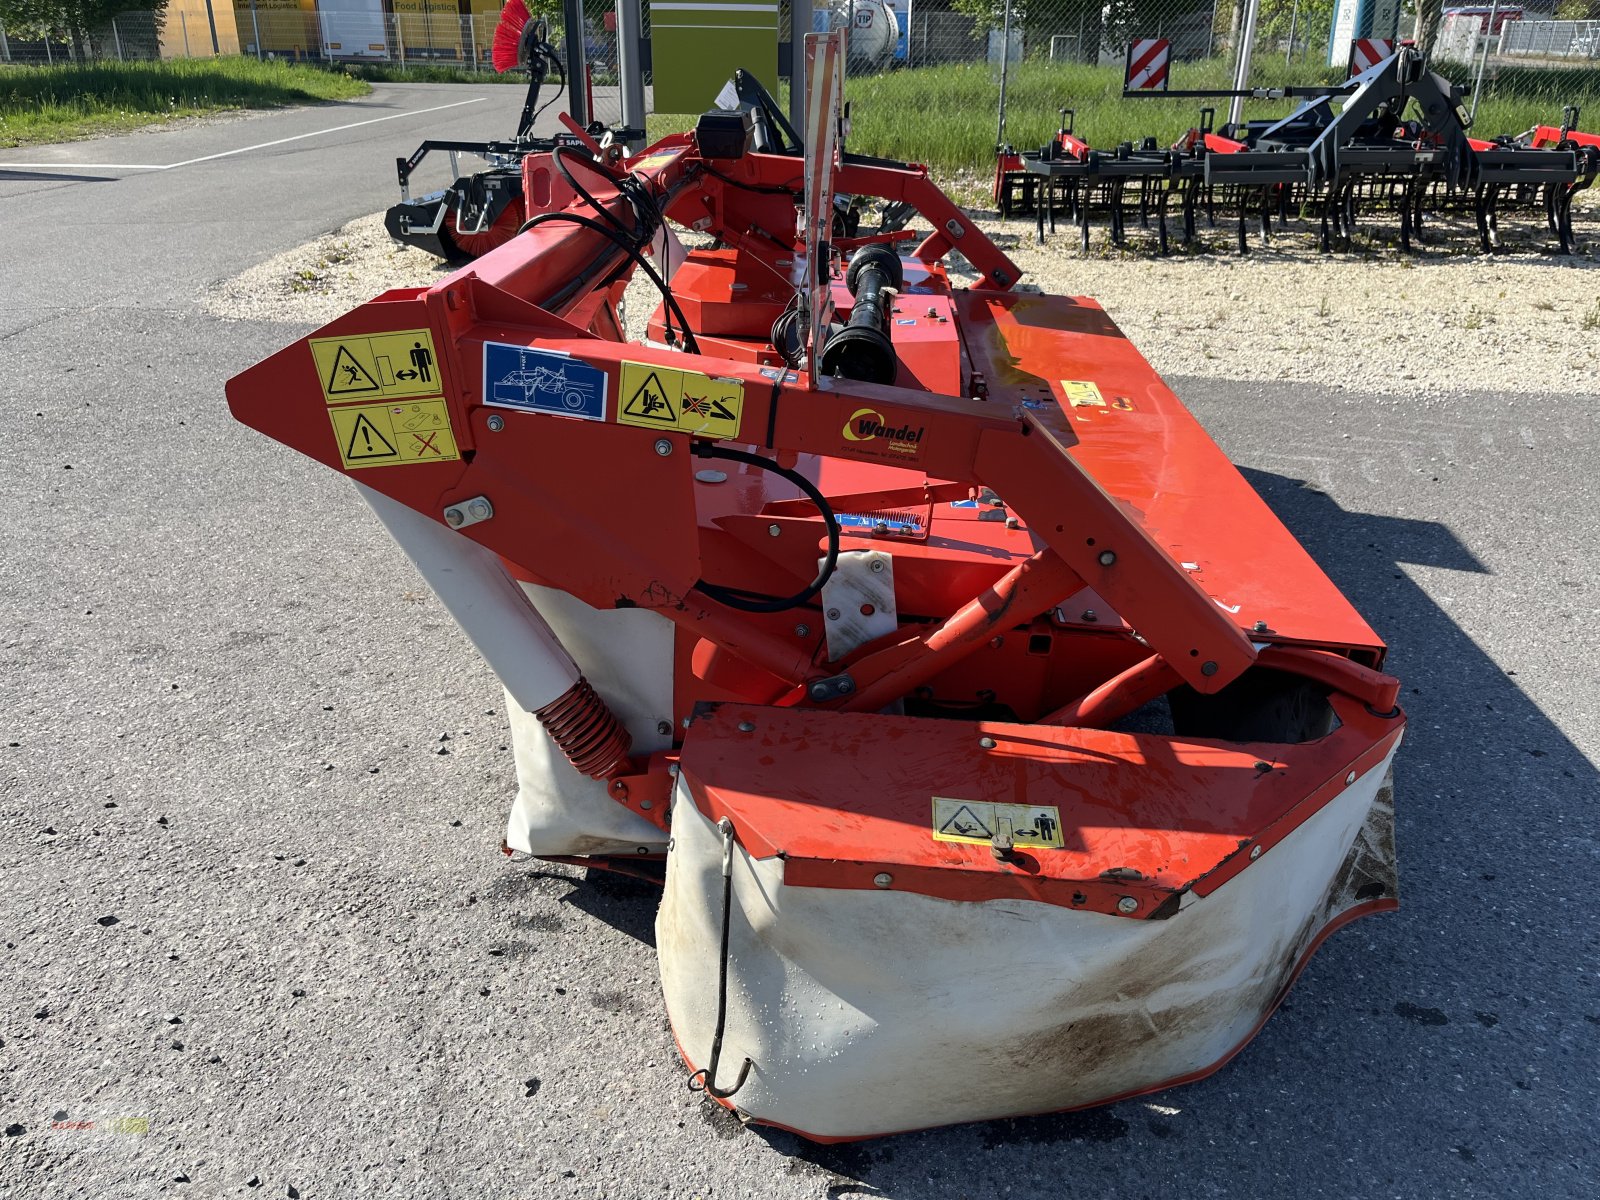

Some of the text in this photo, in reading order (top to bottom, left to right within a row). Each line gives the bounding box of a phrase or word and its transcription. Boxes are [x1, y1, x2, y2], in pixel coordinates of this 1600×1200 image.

[269, 2, 298, 10] Logistics
[395, 2, 416, 10] Food
[857, 14, 871, 24] TIP
[858, 419, 925, 443] Wandel
